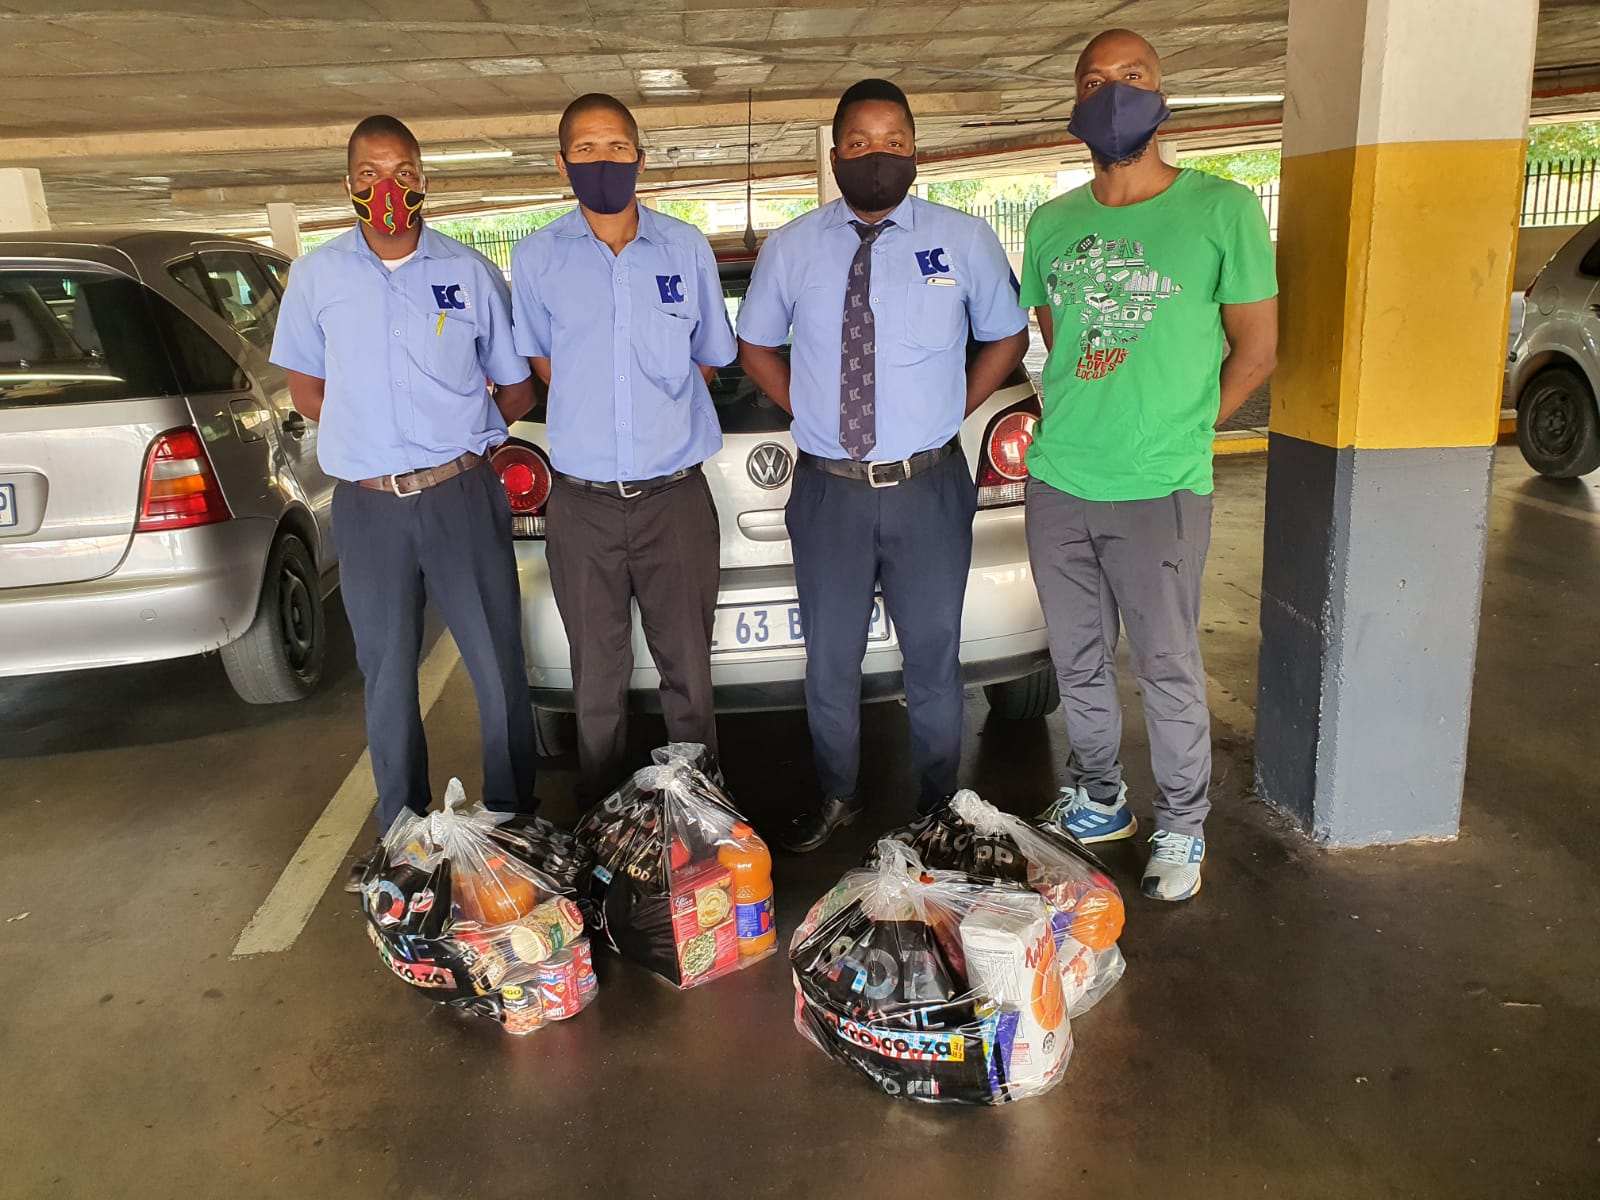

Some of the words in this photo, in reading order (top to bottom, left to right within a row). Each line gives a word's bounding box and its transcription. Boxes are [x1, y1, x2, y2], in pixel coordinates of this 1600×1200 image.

[914, 247, 950, 276] EC
[854, 262, 864, 275] EC
[655, 274, 684, 303] EC
[431, 284, 466, 309] EC
[851, 294, 862, 307] EC
[850, 326, 861, 339] EC
[849, 357, 861, 371] EC
[863, 373, 874, 386] EC
[849, 388, 861, 401] EC
[862, 403, 874, 416] EC
[848, 418, 860, 430] EC
[862, 433, 874, 445] EC
[736, 611, 769, 644] 63
